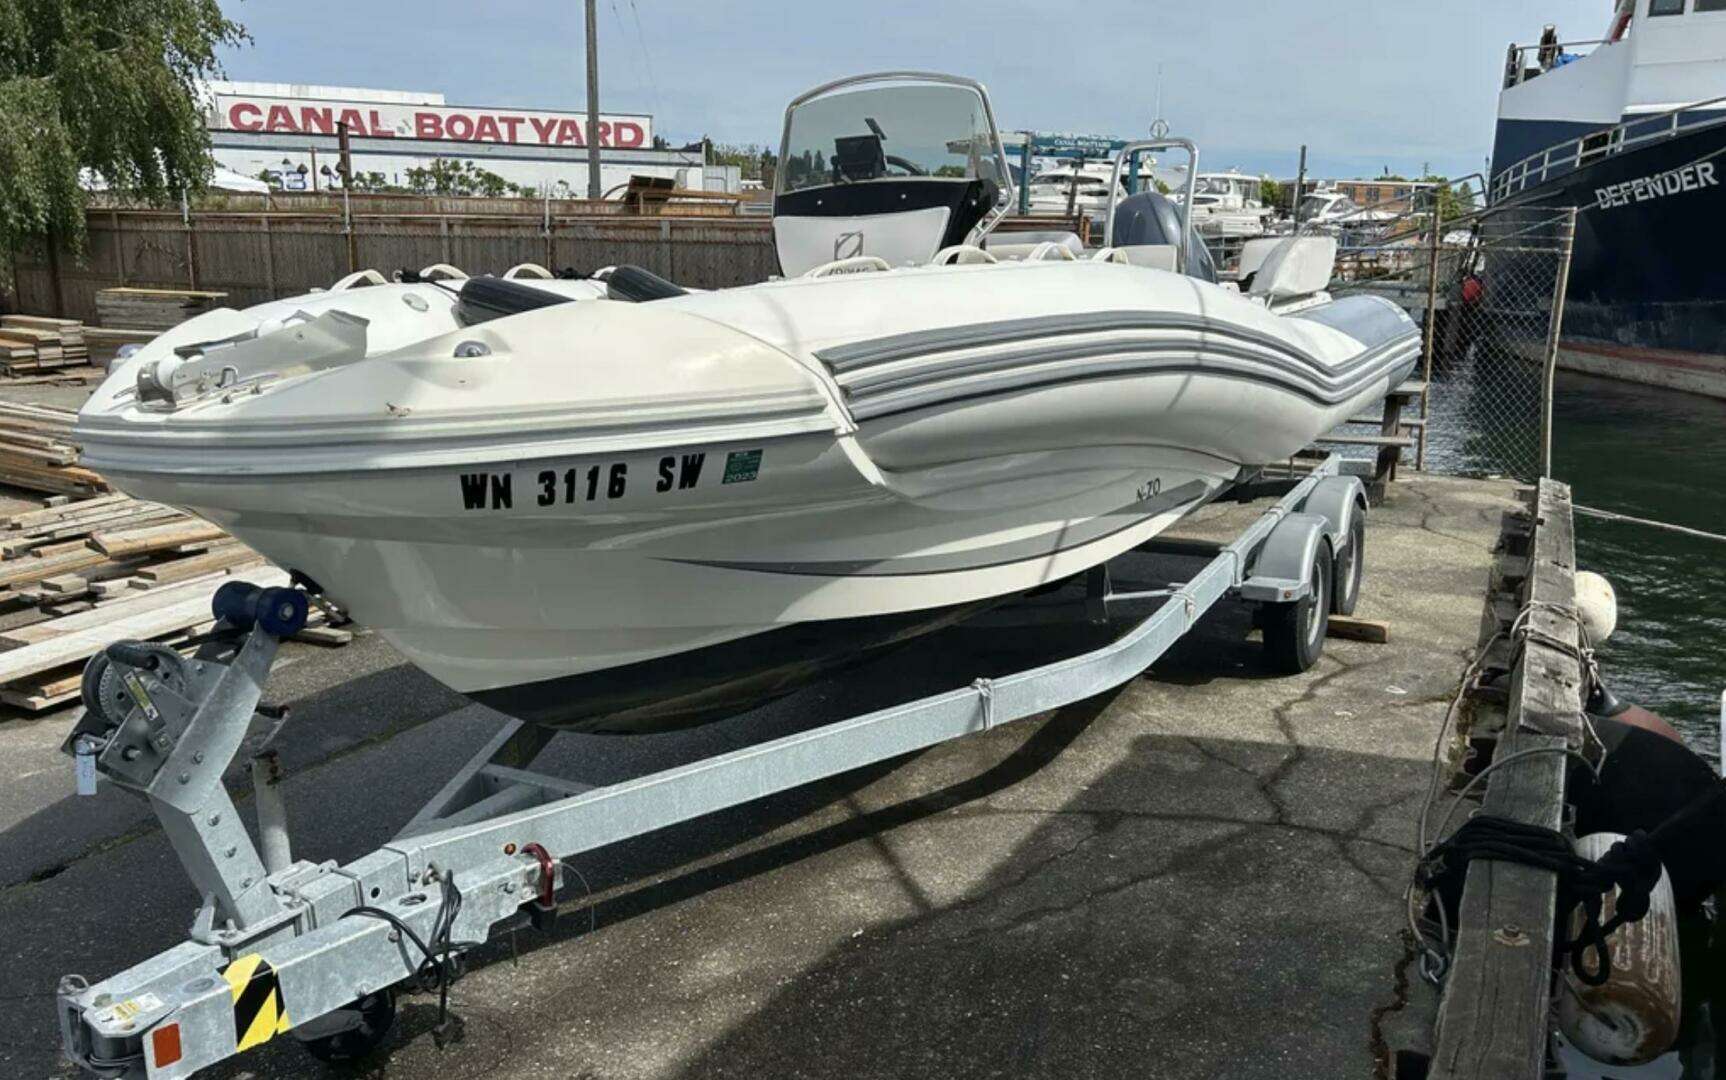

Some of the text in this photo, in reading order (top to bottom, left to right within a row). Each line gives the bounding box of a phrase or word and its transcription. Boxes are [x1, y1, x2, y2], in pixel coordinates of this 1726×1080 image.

[229, 102, 395, 137] CANAL
[1595, 161, 1719, 210] DEFENDER
[460, 473, 513, 510] WN
[537, 462, 627, 507] 3116
[656, 452, 706, 493] SW
